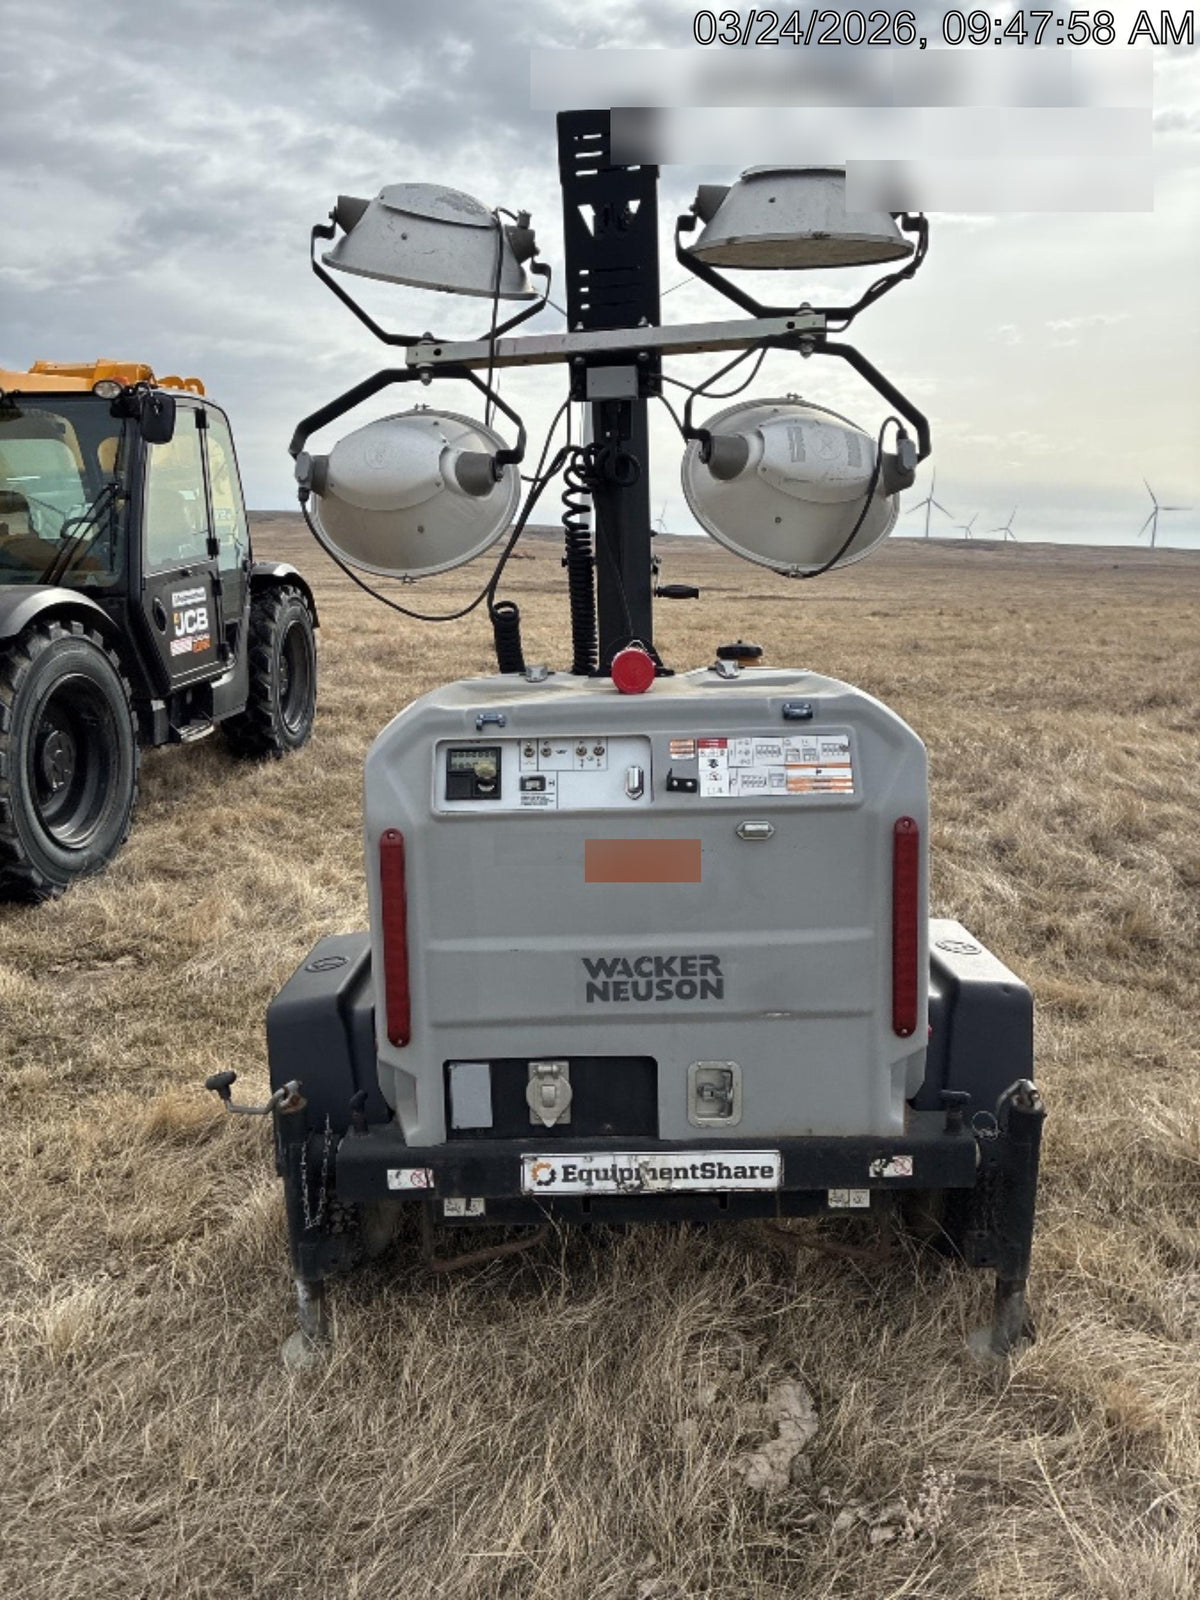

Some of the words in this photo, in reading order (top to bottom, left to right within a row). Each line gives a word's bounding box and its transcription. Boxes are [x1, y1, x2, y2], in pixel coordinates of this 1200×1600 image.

[175, 607, 209, 636] JCB
[581, 954, 725, 979] WACKER
[586, 978, 725, 1003] NEUSON
